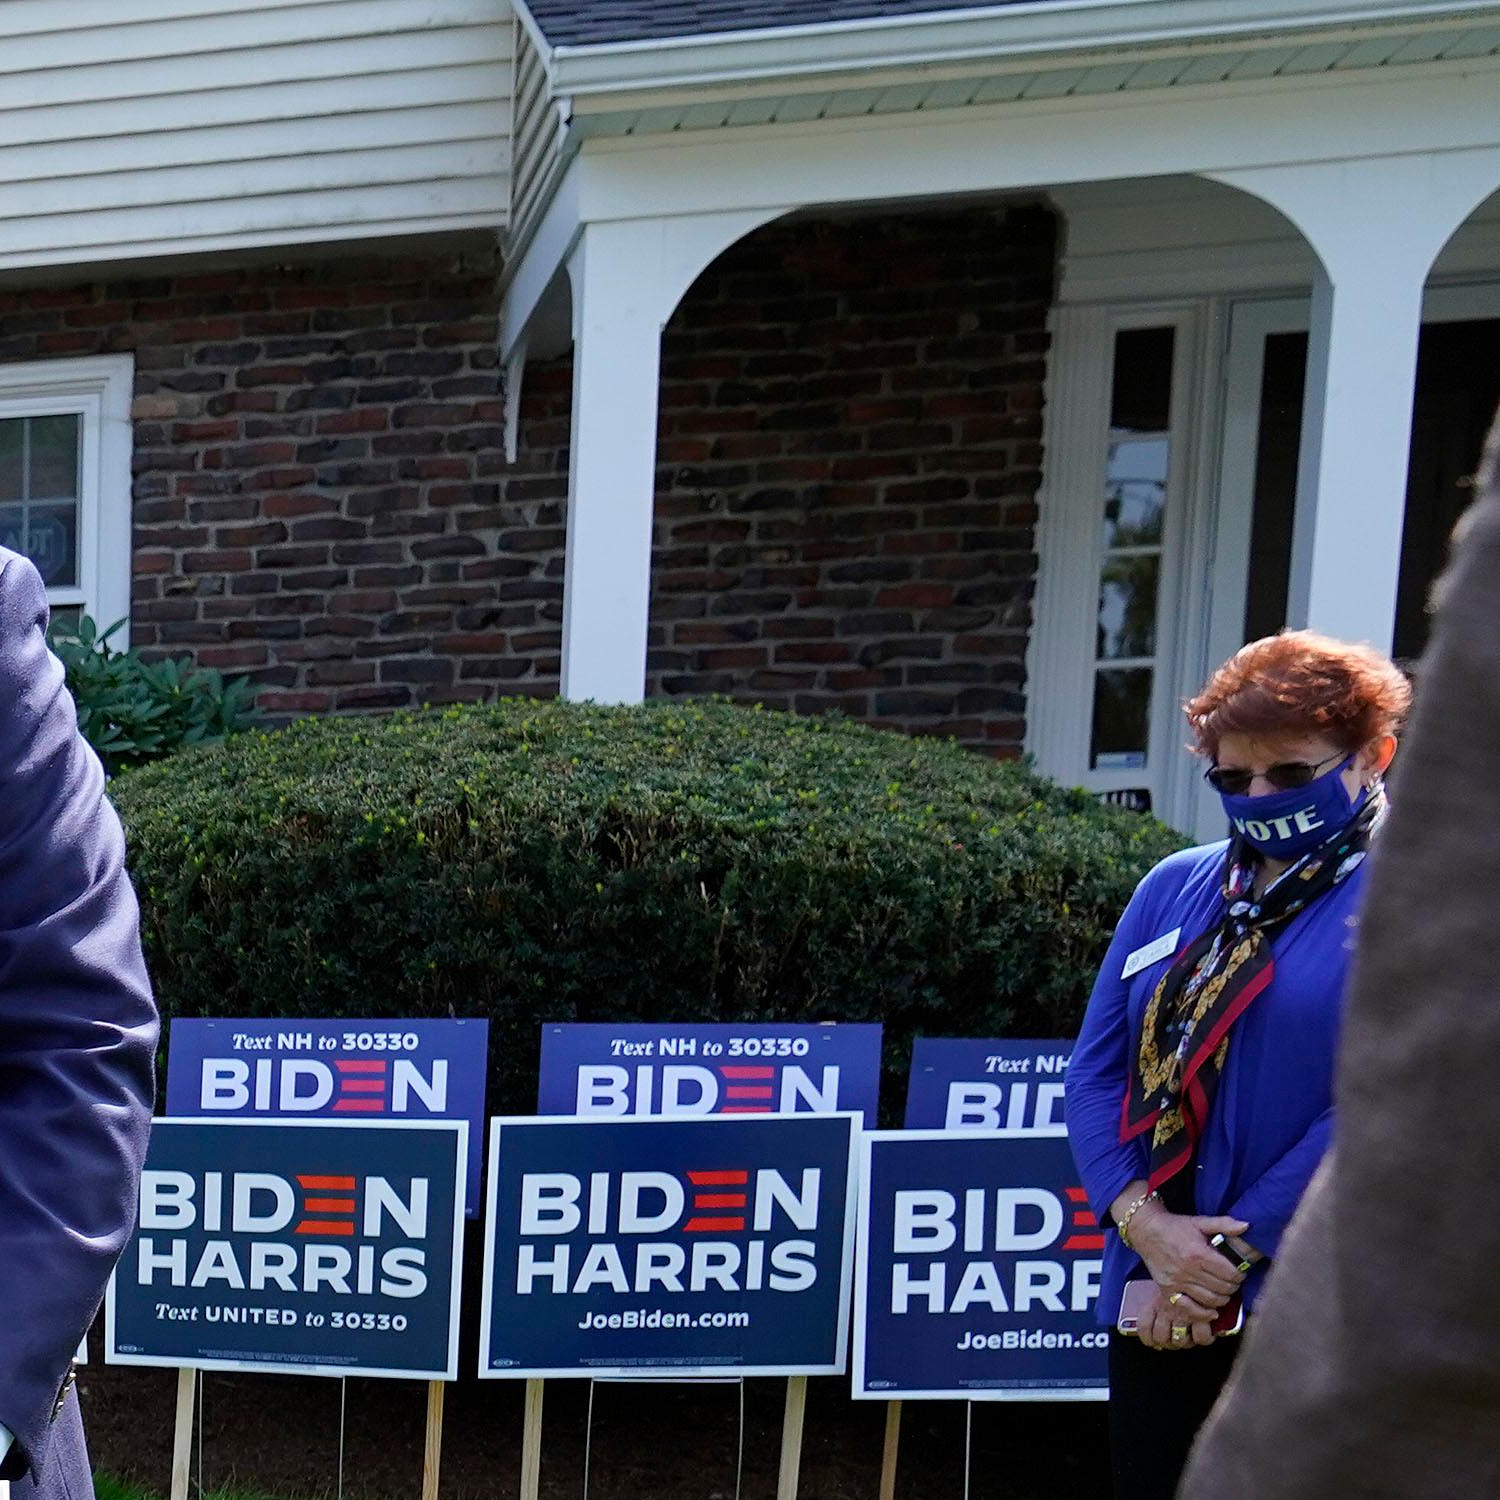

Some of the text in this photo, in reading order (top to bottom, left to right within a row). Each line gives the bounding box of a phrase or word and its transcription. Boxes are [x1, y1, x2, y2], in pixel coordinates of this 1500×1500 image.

[1233, 804, 1324, 842] VOTE
[232, 1032, 419, 1050] Text NH to 30330
[610, 1037, 810, 1056] Text NH to 30330
[984, 1055, 1031, 1074] Text
[200, 1058, 449, 1113] BIDEN
[576, 1065, 840, 1116] BIDEN
[139, 1170, 429, 1239] BIDEN
[519, 1167, 821, 1236] BIDEN
[893, 1187, 1106, 1254] BIDE
[138, 1238, 428, 1298] HARRIS
[516, 1239, 818, 1295] HARRIS
[891, 1259, 1103, 1314] HARR
[155, 1303, 407, 1331] Text UNITED to 30330
[578, 1308, 749, 1330] JoeBiden.com
[956, 1329, 1110, 1350] JoeBiden.co
